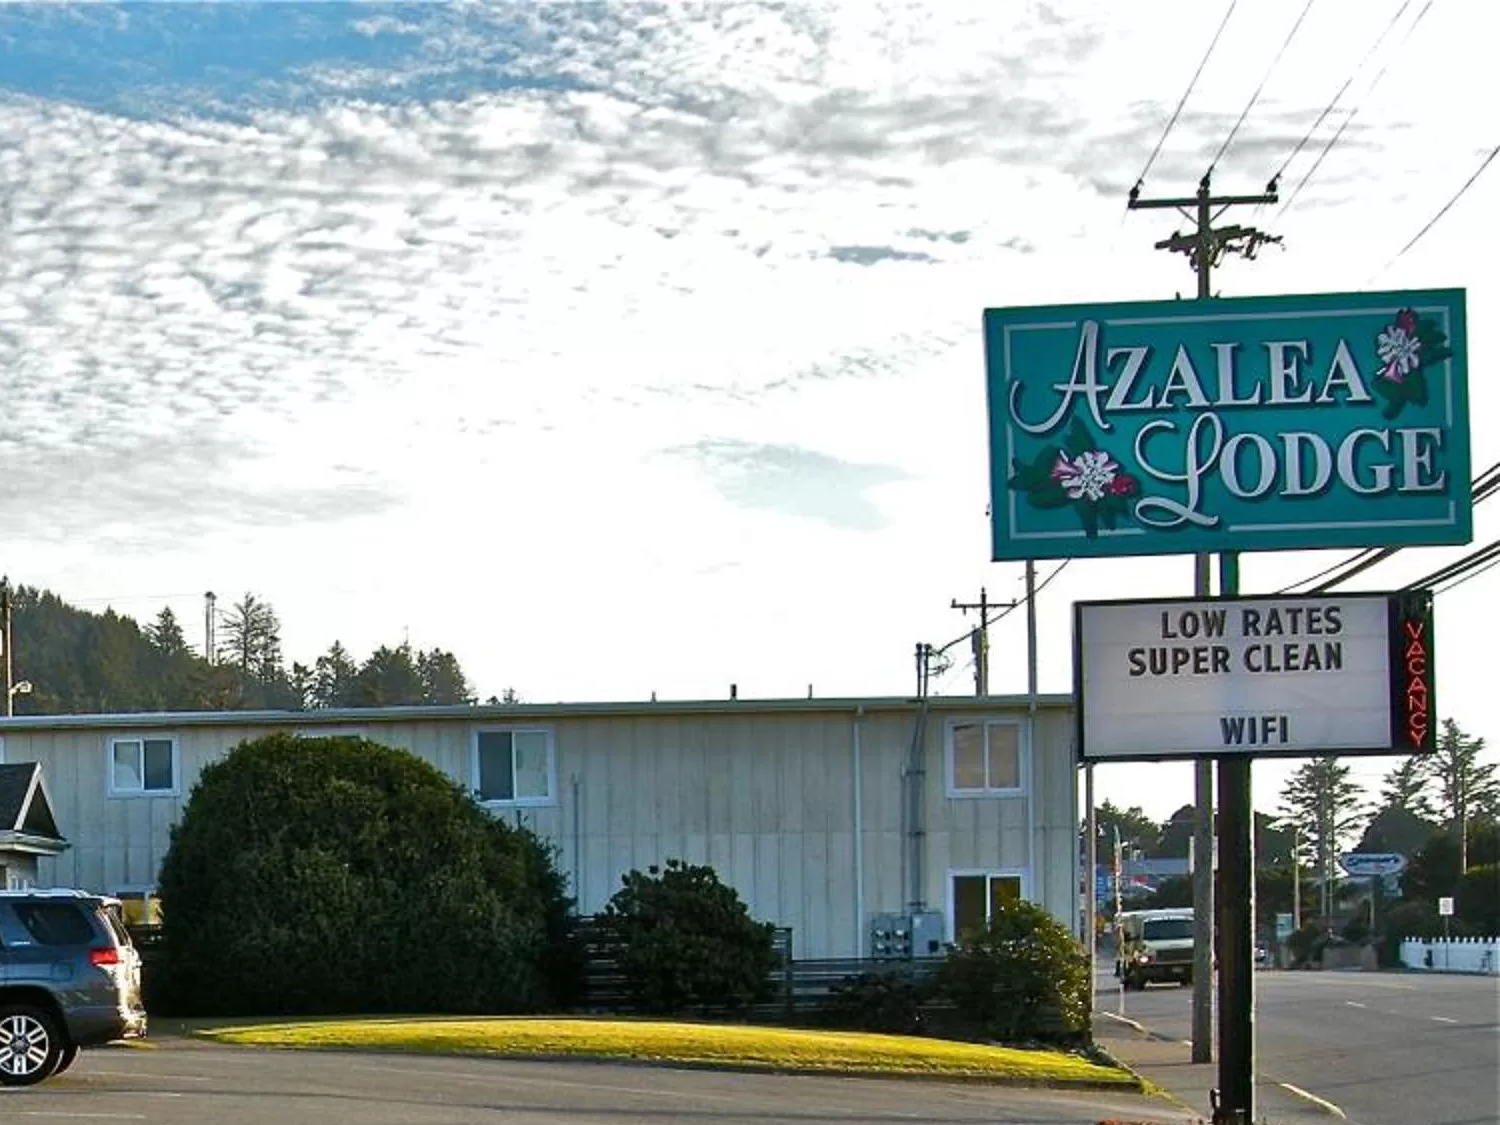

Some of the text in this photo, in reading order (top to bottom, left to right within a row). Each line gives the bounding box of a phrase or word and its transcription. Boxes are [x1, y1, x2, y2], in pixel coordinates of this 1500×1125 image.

[1010, 321, 1372, 433] AZALEA
[1134, 411, 1445, 527] LODGE
[1128, 642, 1343, 676] SUPER CLEAN
[1161, 606, 1343, 639] LOW RATES
[1405, 622, 1428, 746] VACANCY
[1220, 716, 1289, 745] WIFI
